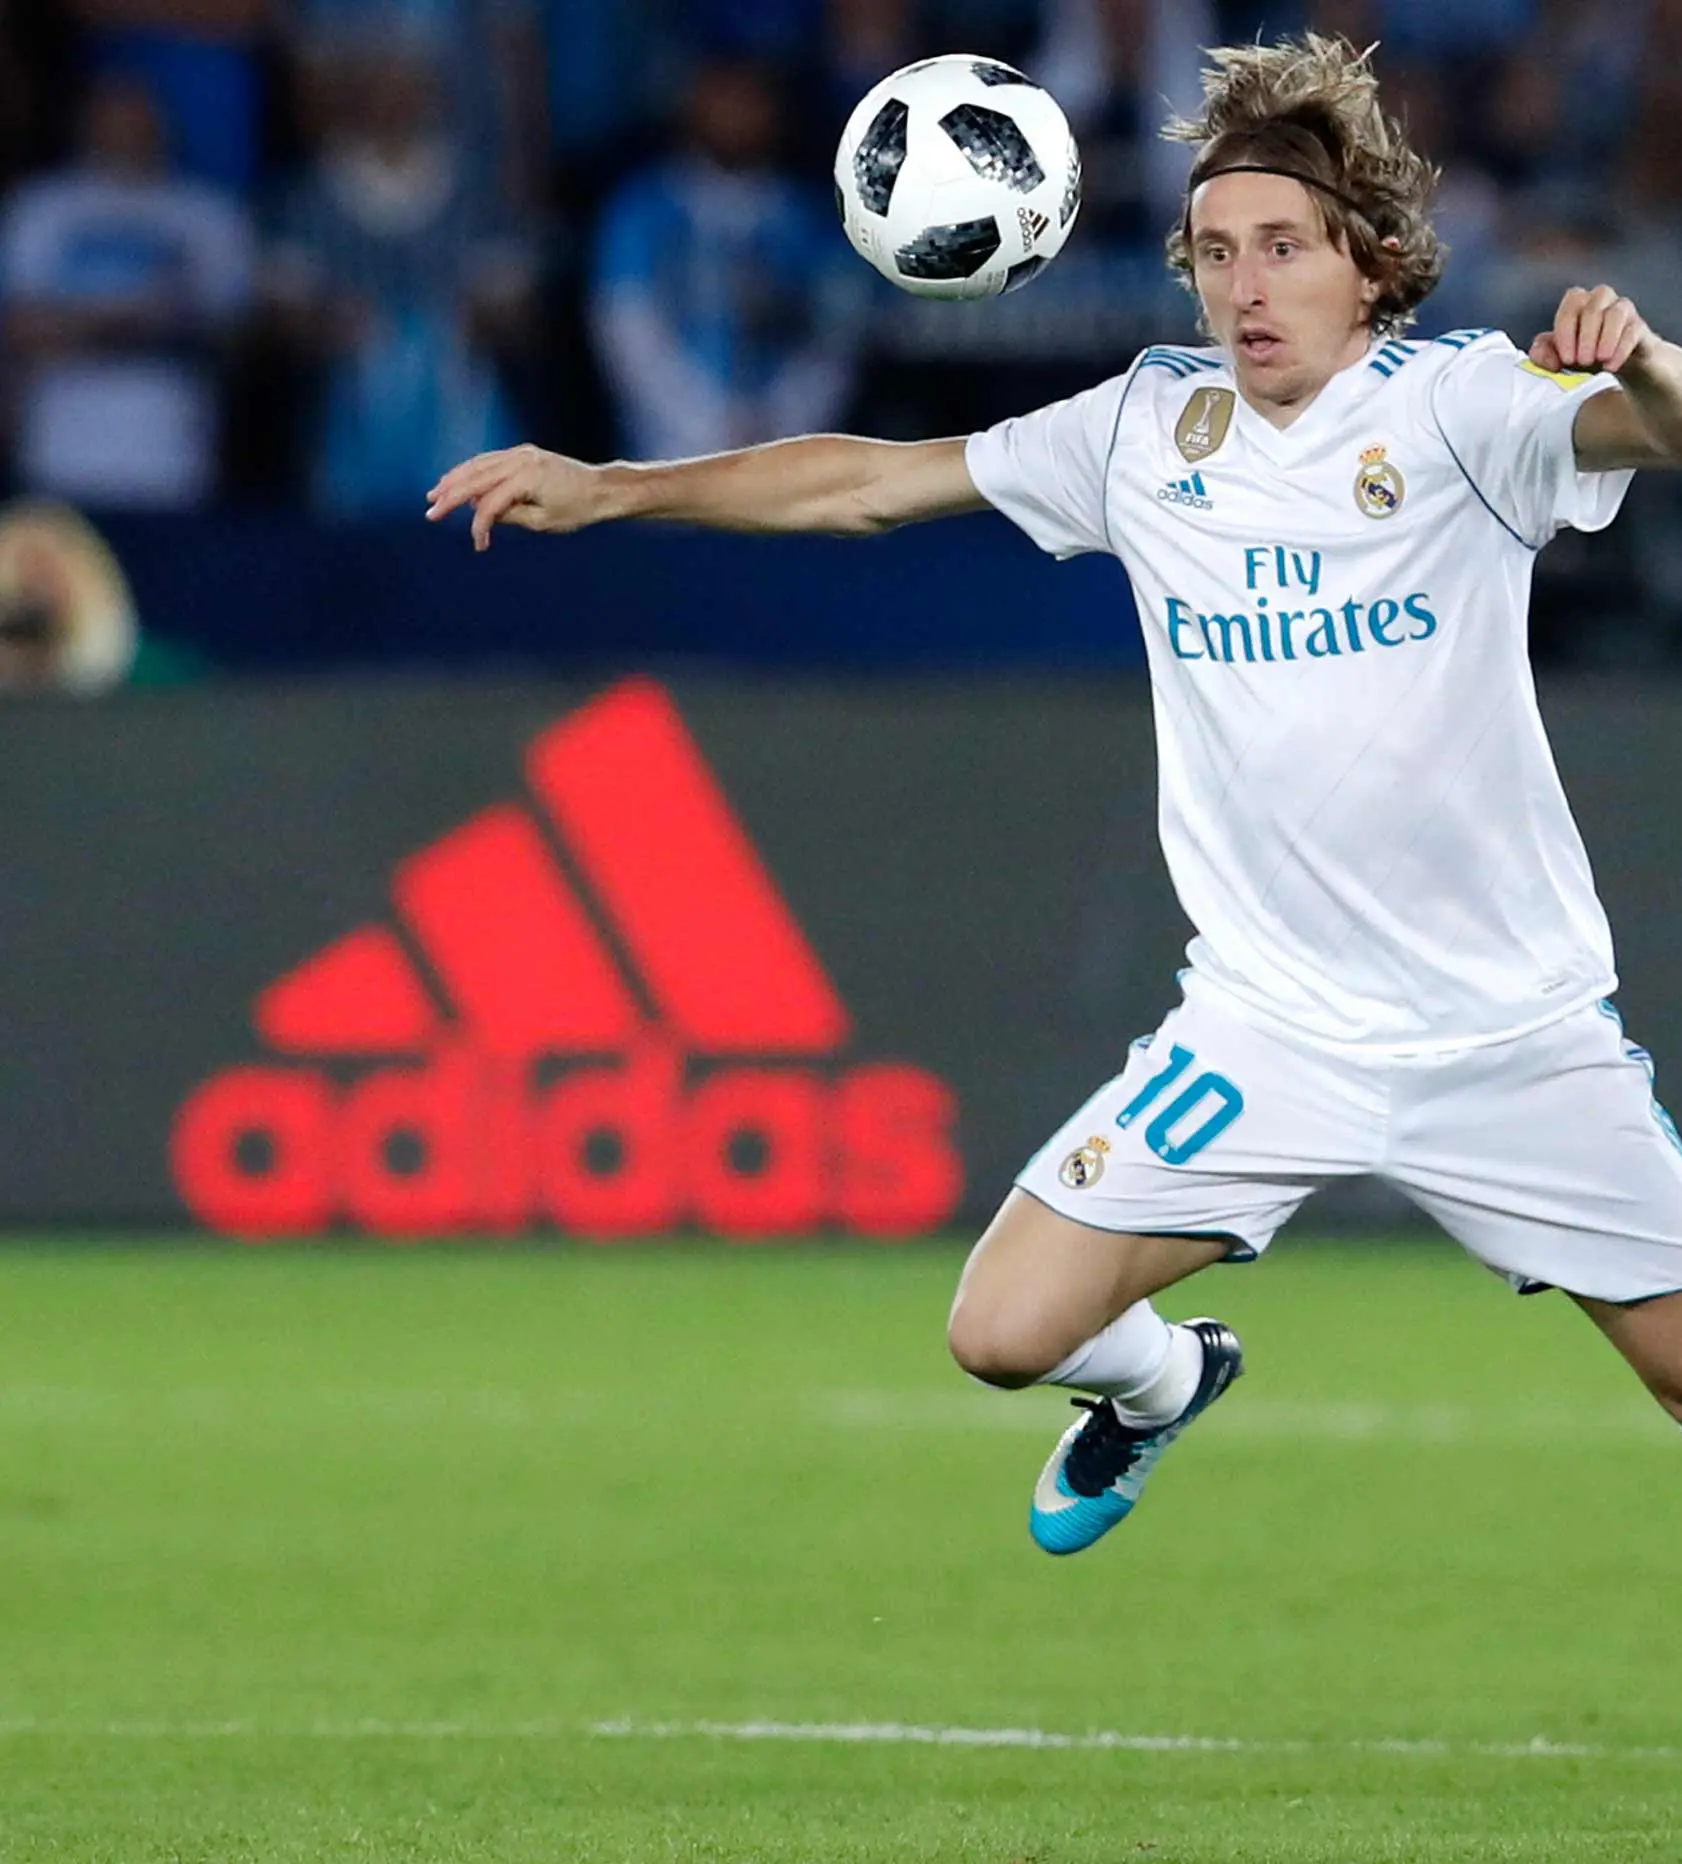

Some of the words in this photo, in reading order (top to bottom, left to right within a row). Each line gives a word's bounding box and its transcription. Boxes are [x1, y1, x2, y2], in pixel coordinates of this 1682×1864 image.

[1158, 489, 1213, 510] adidas
[1244, 545, 1321, 596] Fly
[1164, 592, 1437, 662] Emirates
[1115, 1042, 1244, 1165] 10
[172, 1042, 962, 1238] adidas
